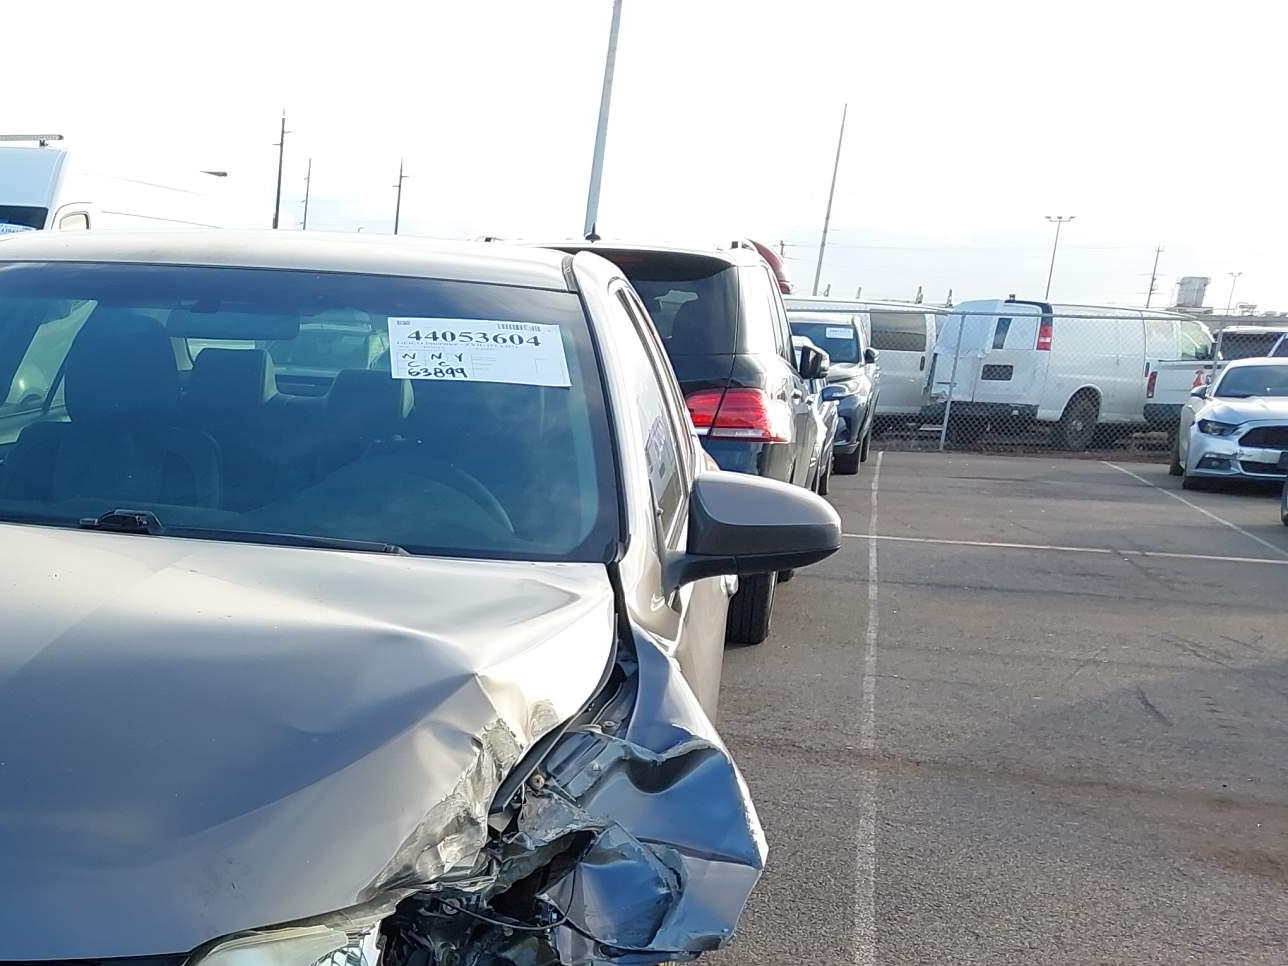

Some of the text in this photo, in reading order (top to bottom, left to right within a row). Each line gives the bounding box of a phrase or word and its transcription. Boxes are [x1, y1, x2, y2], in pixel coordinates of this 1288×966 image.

[407, 329, 541, 347] 44053604
[431, 352, 442, 360] N
[455, 352, 463, 362] Y
[407, 367, 468, 378] 63899
